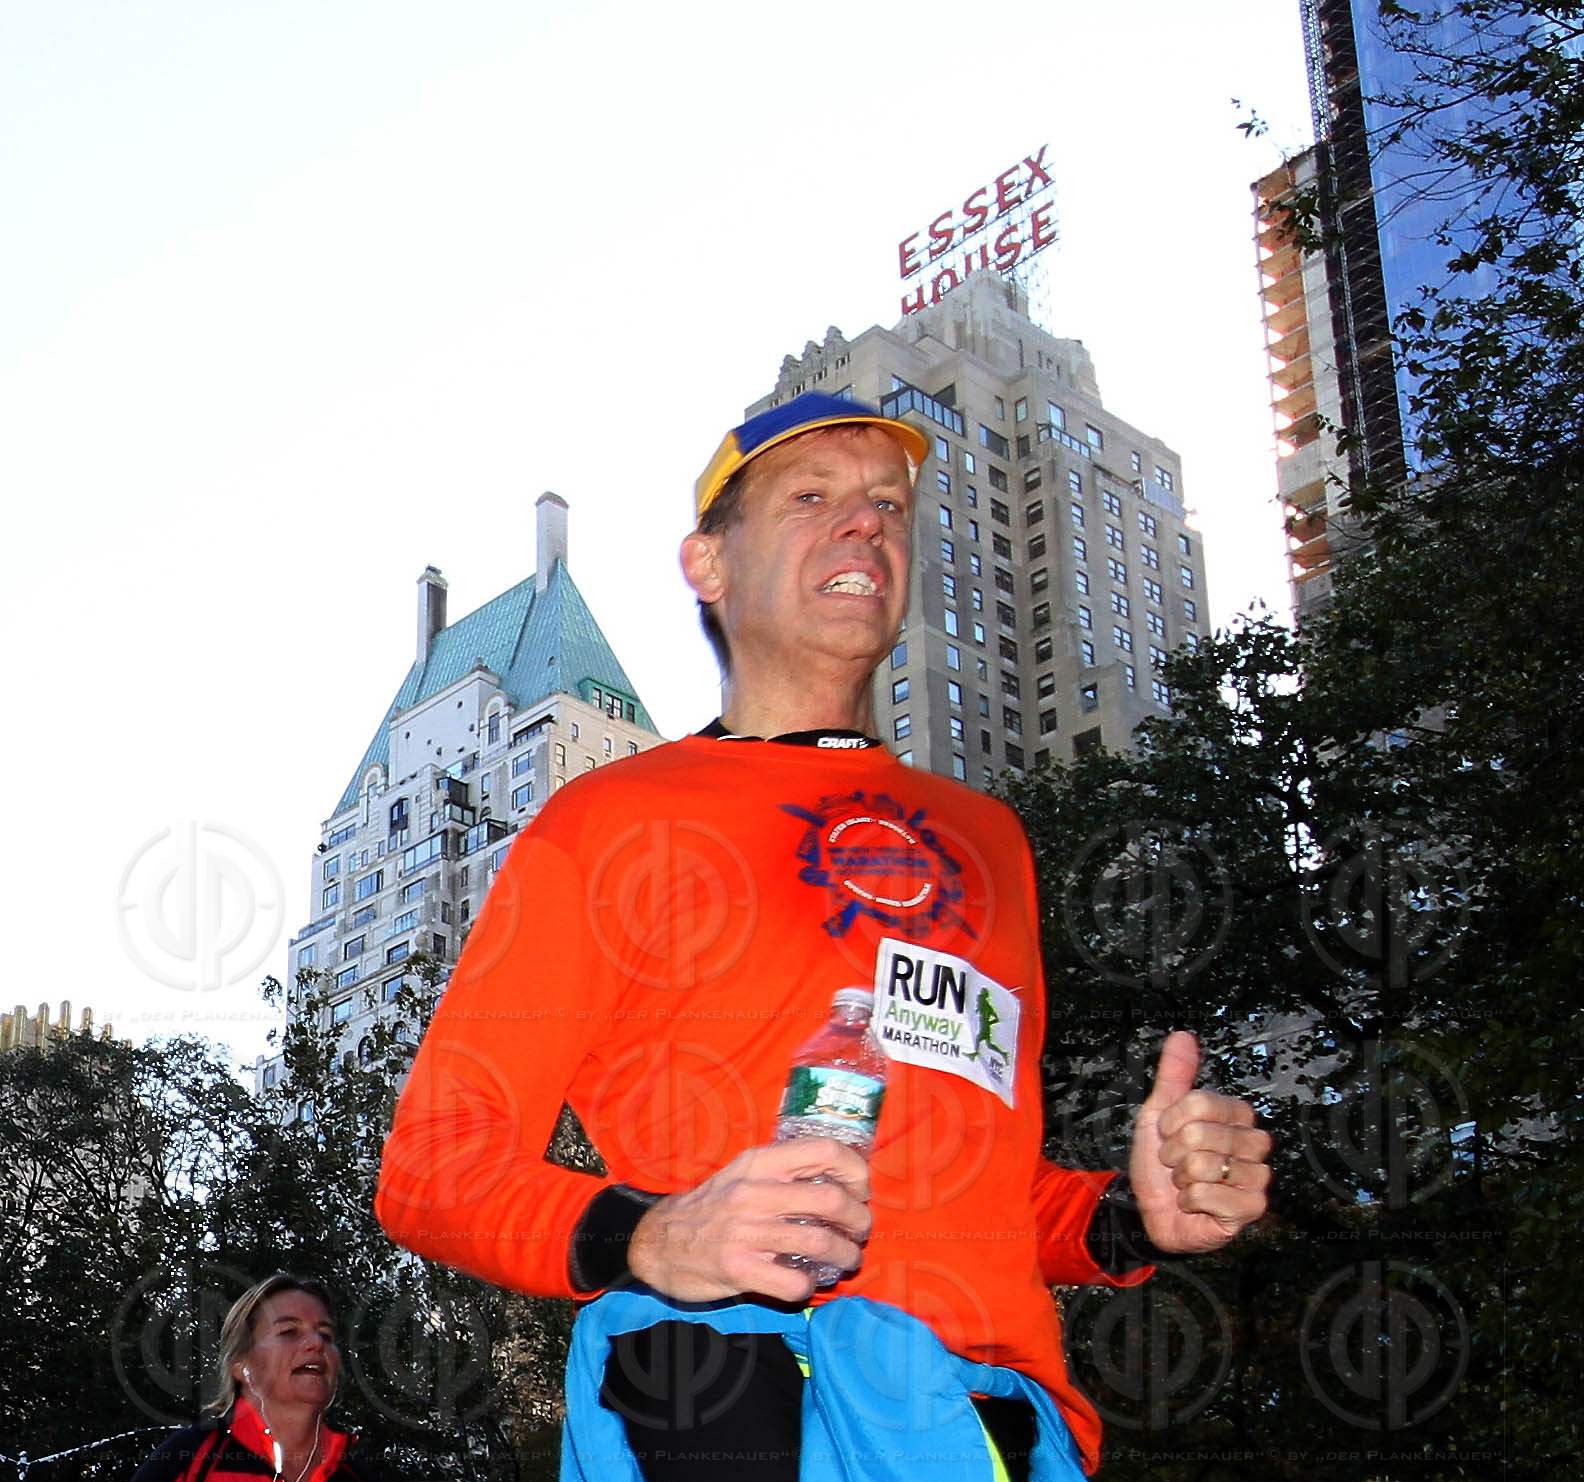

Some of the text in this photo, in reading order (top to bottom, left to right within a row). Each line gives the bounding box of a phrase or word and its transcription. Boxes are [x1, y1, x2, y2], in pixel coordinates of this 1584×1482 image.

[898, 144, 1052, 278] ESSEX
[888, 952, 967, 1015] RUN
[882, 1025, 961, 1059] MARATHON
[884, 999, 965, 1041] Anyway
